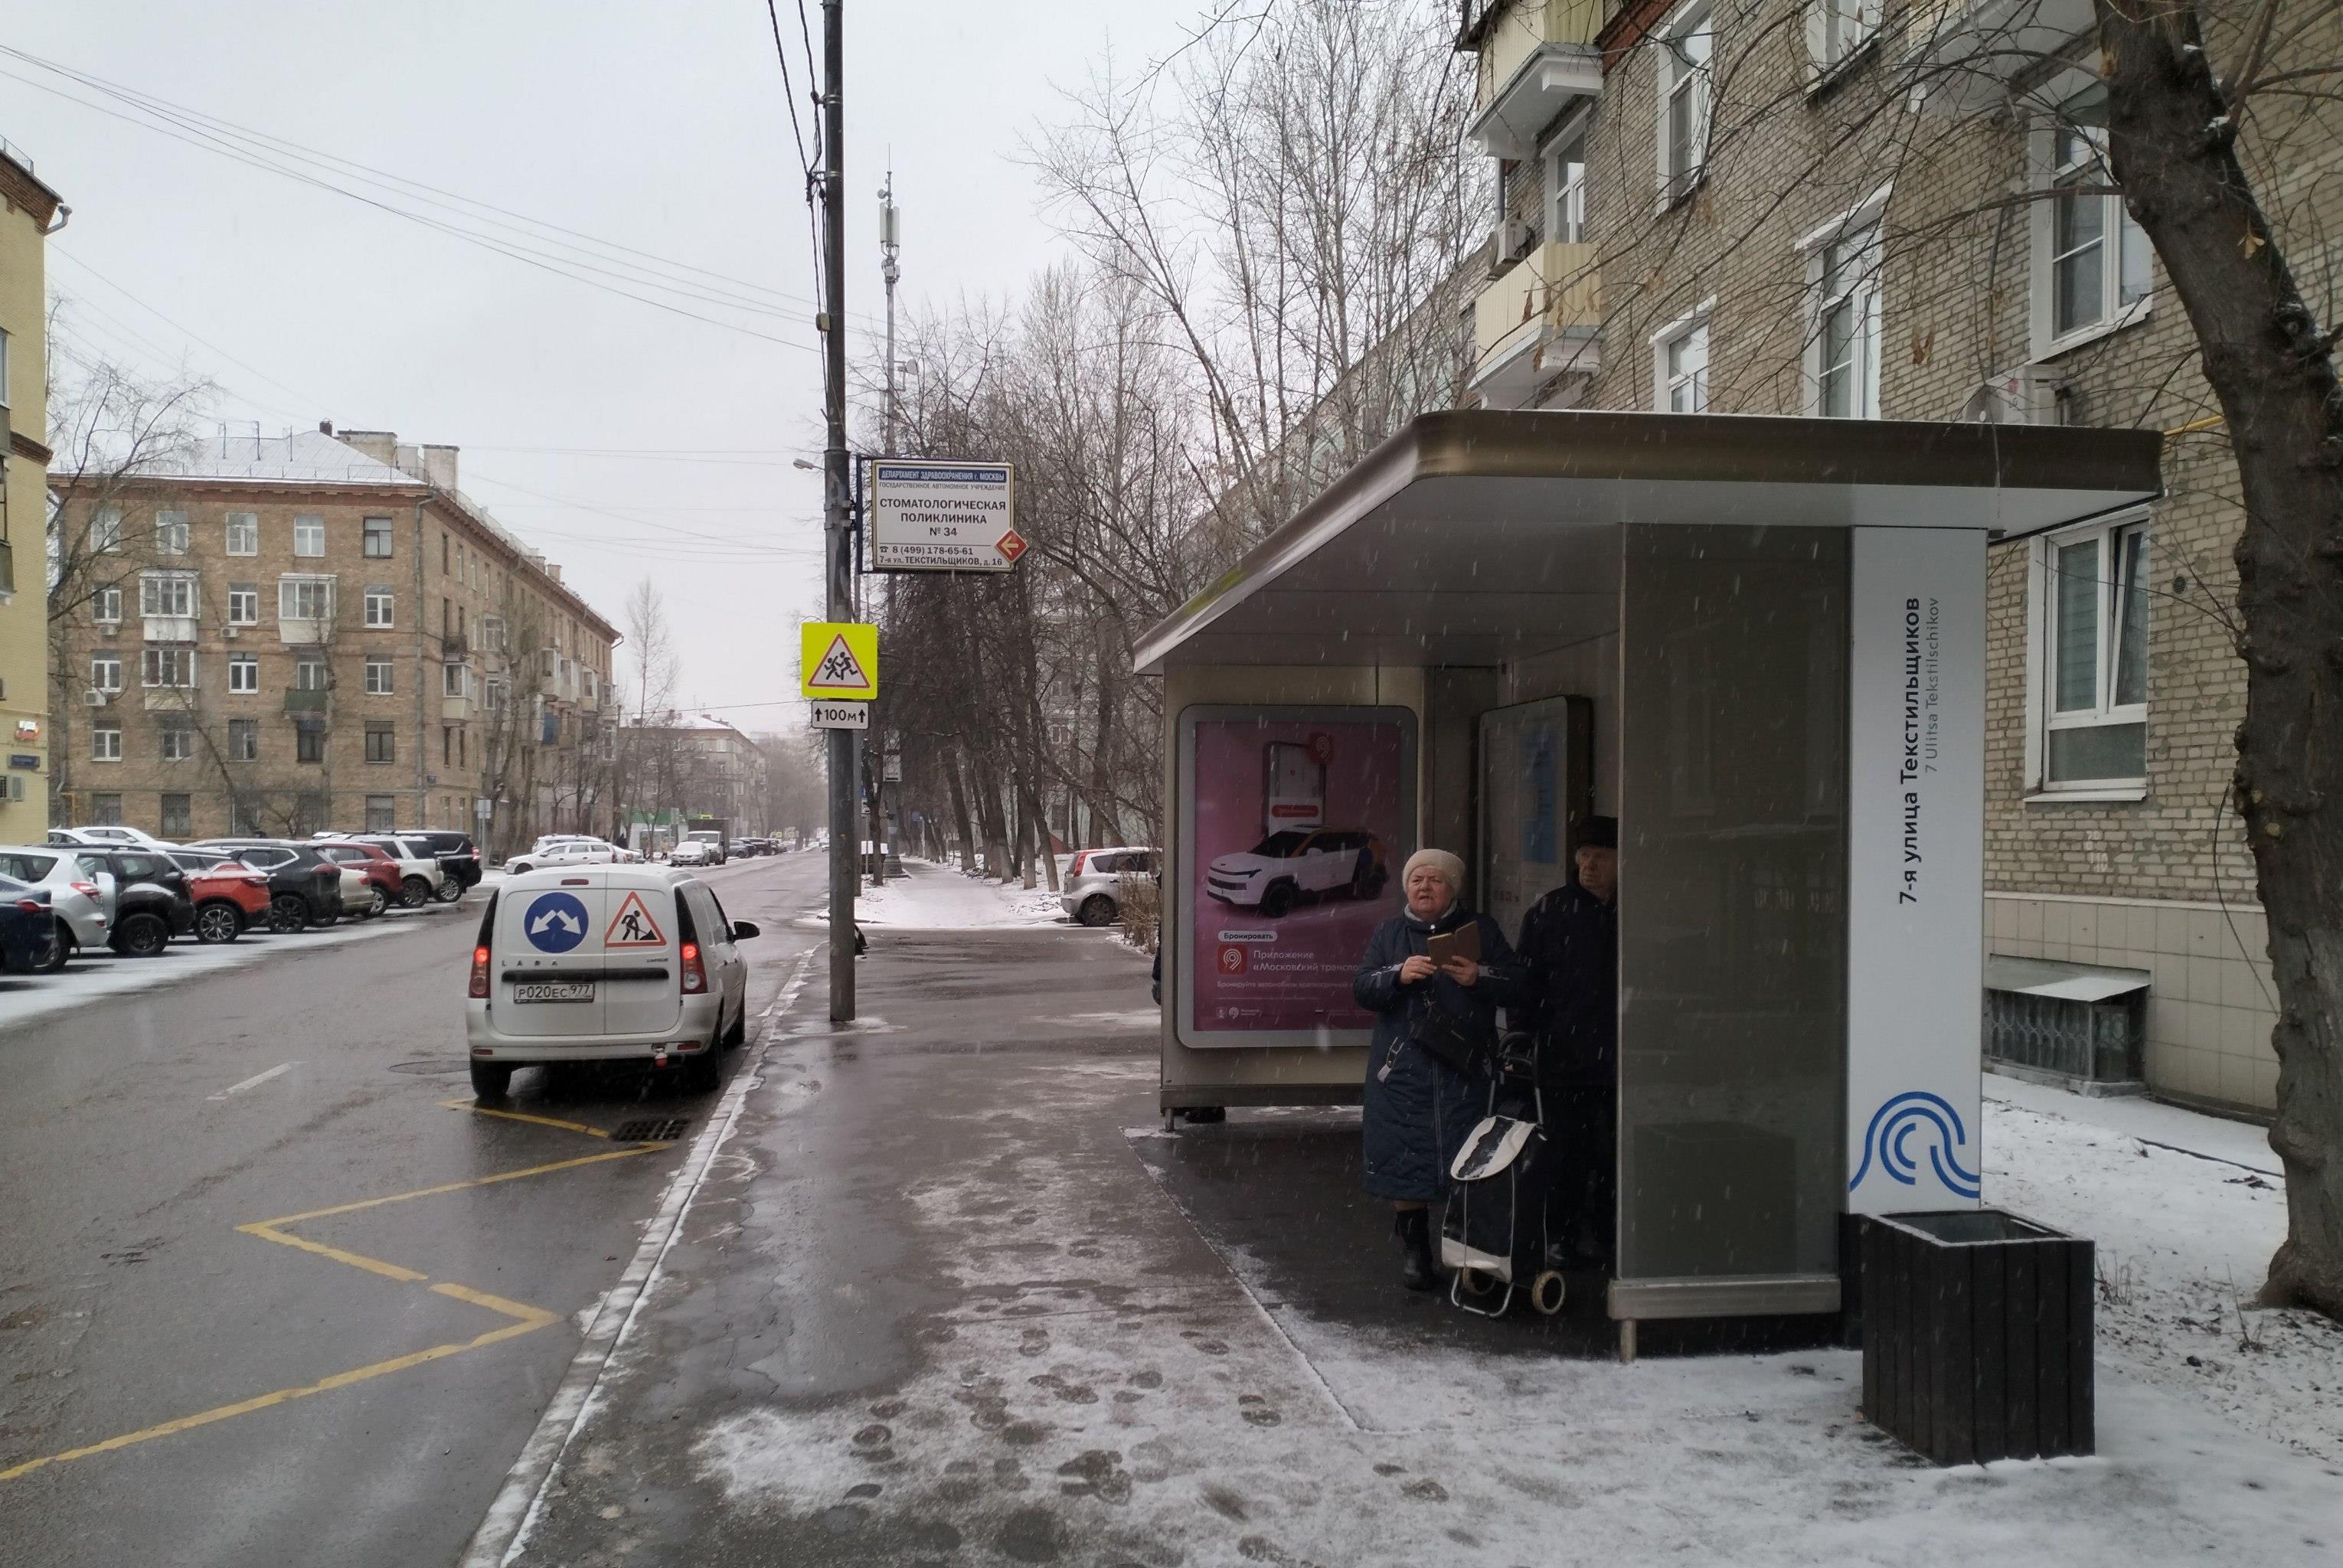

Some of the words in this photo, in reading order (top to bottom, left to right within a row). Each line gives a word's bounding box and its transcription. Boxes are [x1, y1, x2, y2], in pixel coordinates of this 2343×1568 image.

[881, 470, 919, 479] ДЕПАРТАМЕНТ
[920, 471, 973, 480] ЗДРАВООХРАНЕНИЯ
[880, 498, 1006, 510] СТОМАТОЛОГИЧЕСКАЯ
[900, 512, 987, 524] ПОЛИКЛИНИКА
[930, 528, 941, 536] №
[943, 528, 957, 536] 34
[900, 547, 925, 555] (499)
[927, 547, 973, 555] 178-65-61
[880, 555, 891, 564] 7-я
[904, 556, 982, 567] ТЕКСТИЛЬЩИКОВ,
[1925, 598, 1940, 710] Tekstilschikov
[1900, 597, 1922, 784] Текстильщиков
[1925, 713, 1939, 759] Ulitsa
[1904, 792, 1922, 863] улица
[1899, 870, 1917, 904] 7-я
[1253, 949, 1315, 960] Приложение
[1253, 962, 1319, 972] «Московский
